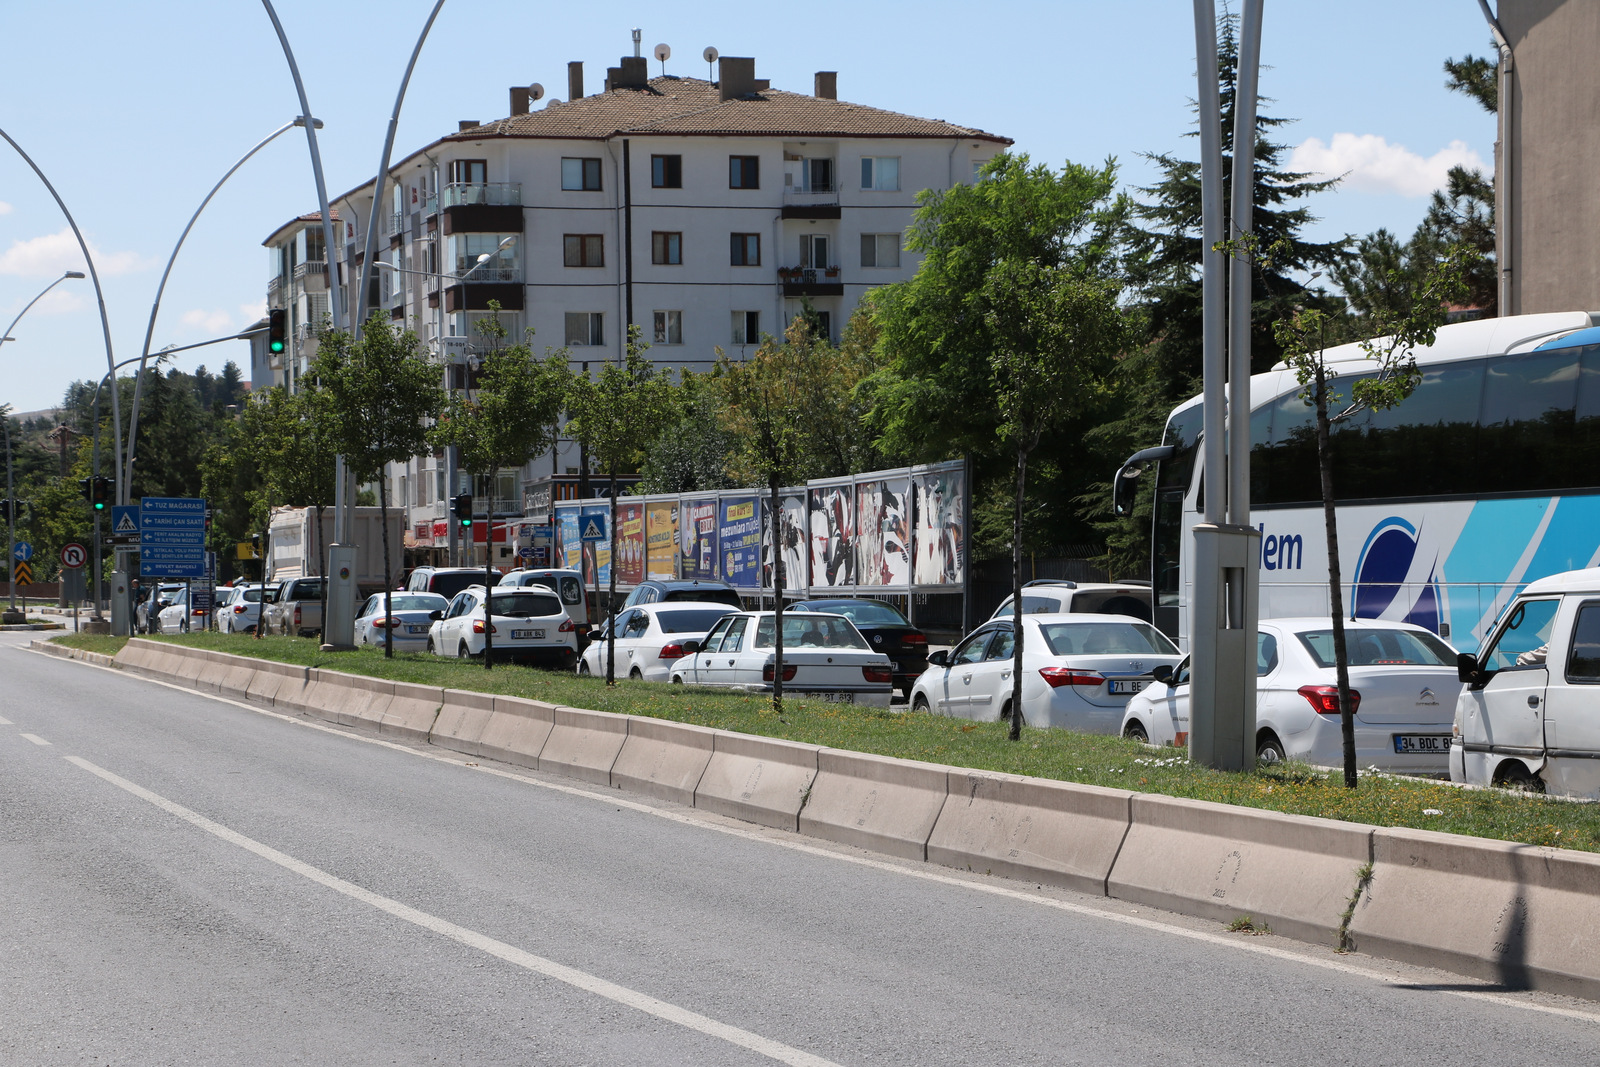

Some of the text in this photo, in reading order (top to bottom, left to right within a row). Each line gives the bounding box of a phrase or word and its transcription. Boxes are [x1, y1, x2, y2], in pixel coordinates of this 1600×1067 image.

[168, 502, 203, 510] MAĞARASI
[418, 527, 427, 537] E
[1114, 681, 1142, 692] 71 BE
[1401, 737, 1415, 750] 34
[1418, 737, 1439, 750] BDC
